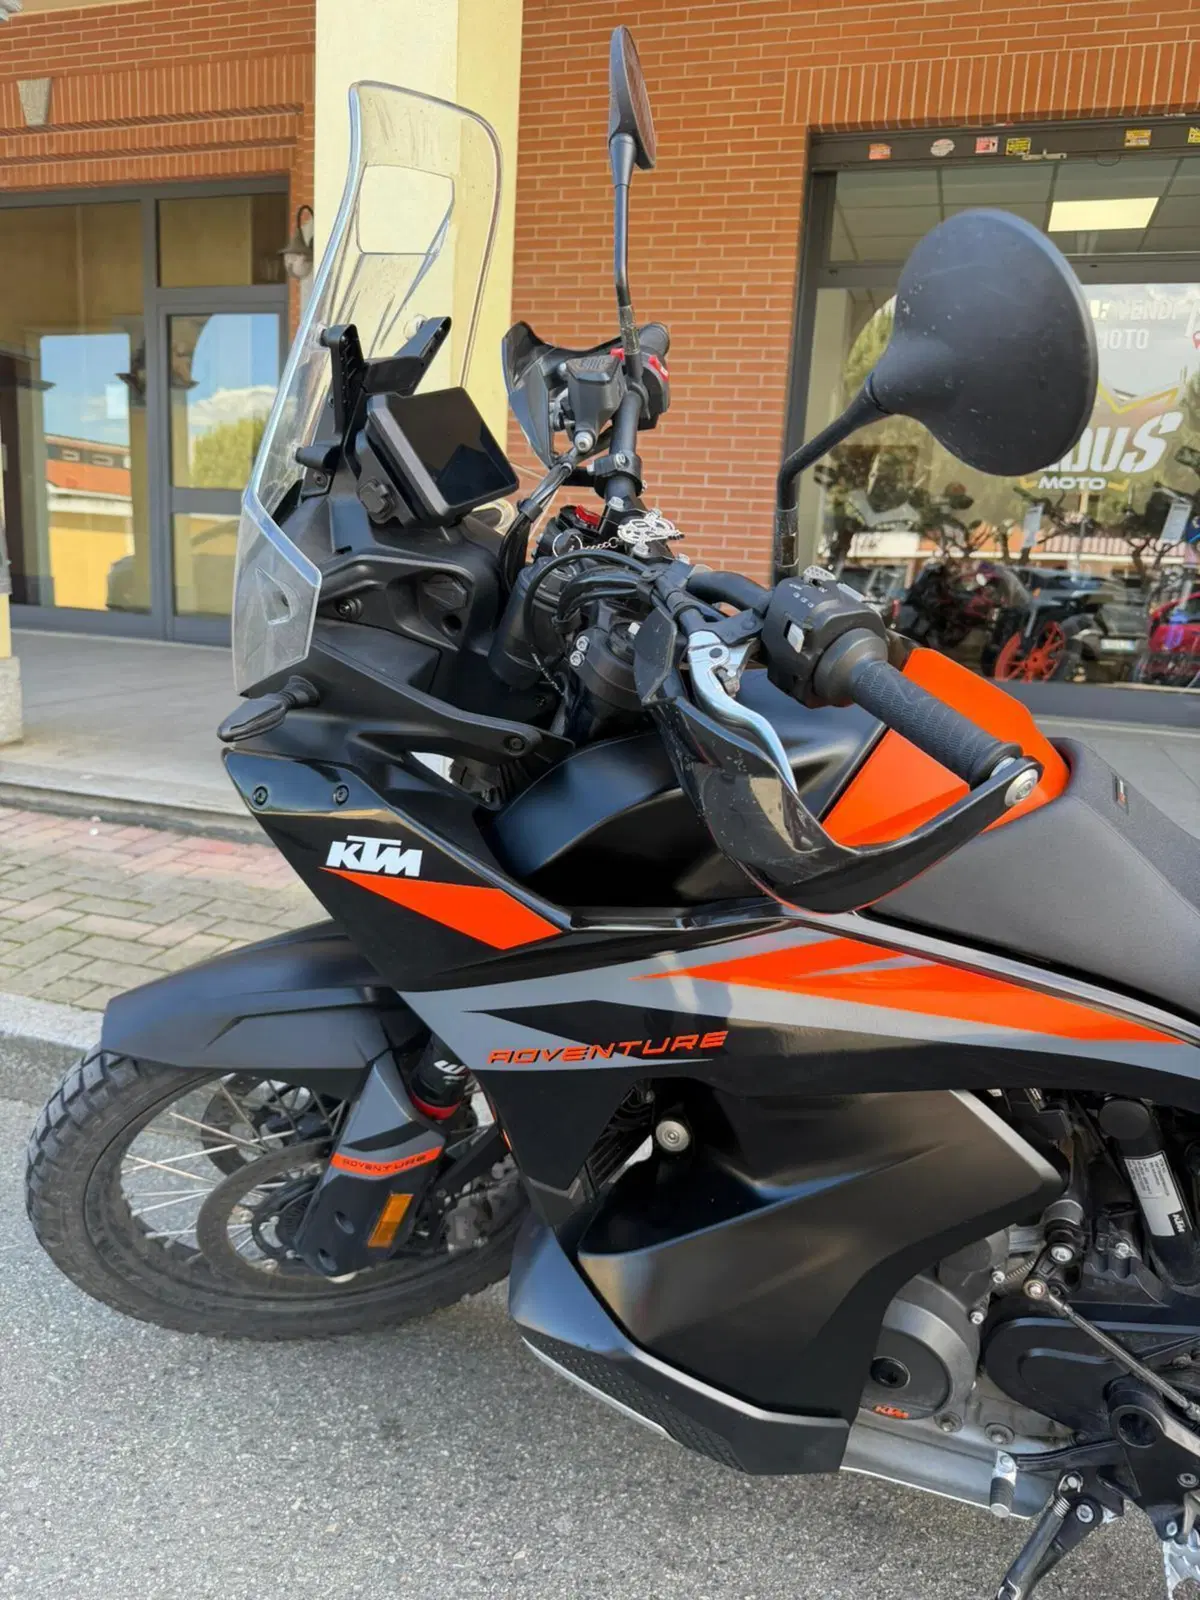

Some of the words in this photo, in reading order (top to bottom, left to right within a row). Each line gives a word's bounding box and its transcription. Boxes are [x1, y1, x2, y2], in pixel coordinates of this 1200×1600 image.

[1038, 476, 1107, 490] MOTO
[325, 834, 423, 877] KTM
[487, 1030, 729, 1065] ADVENTURE
